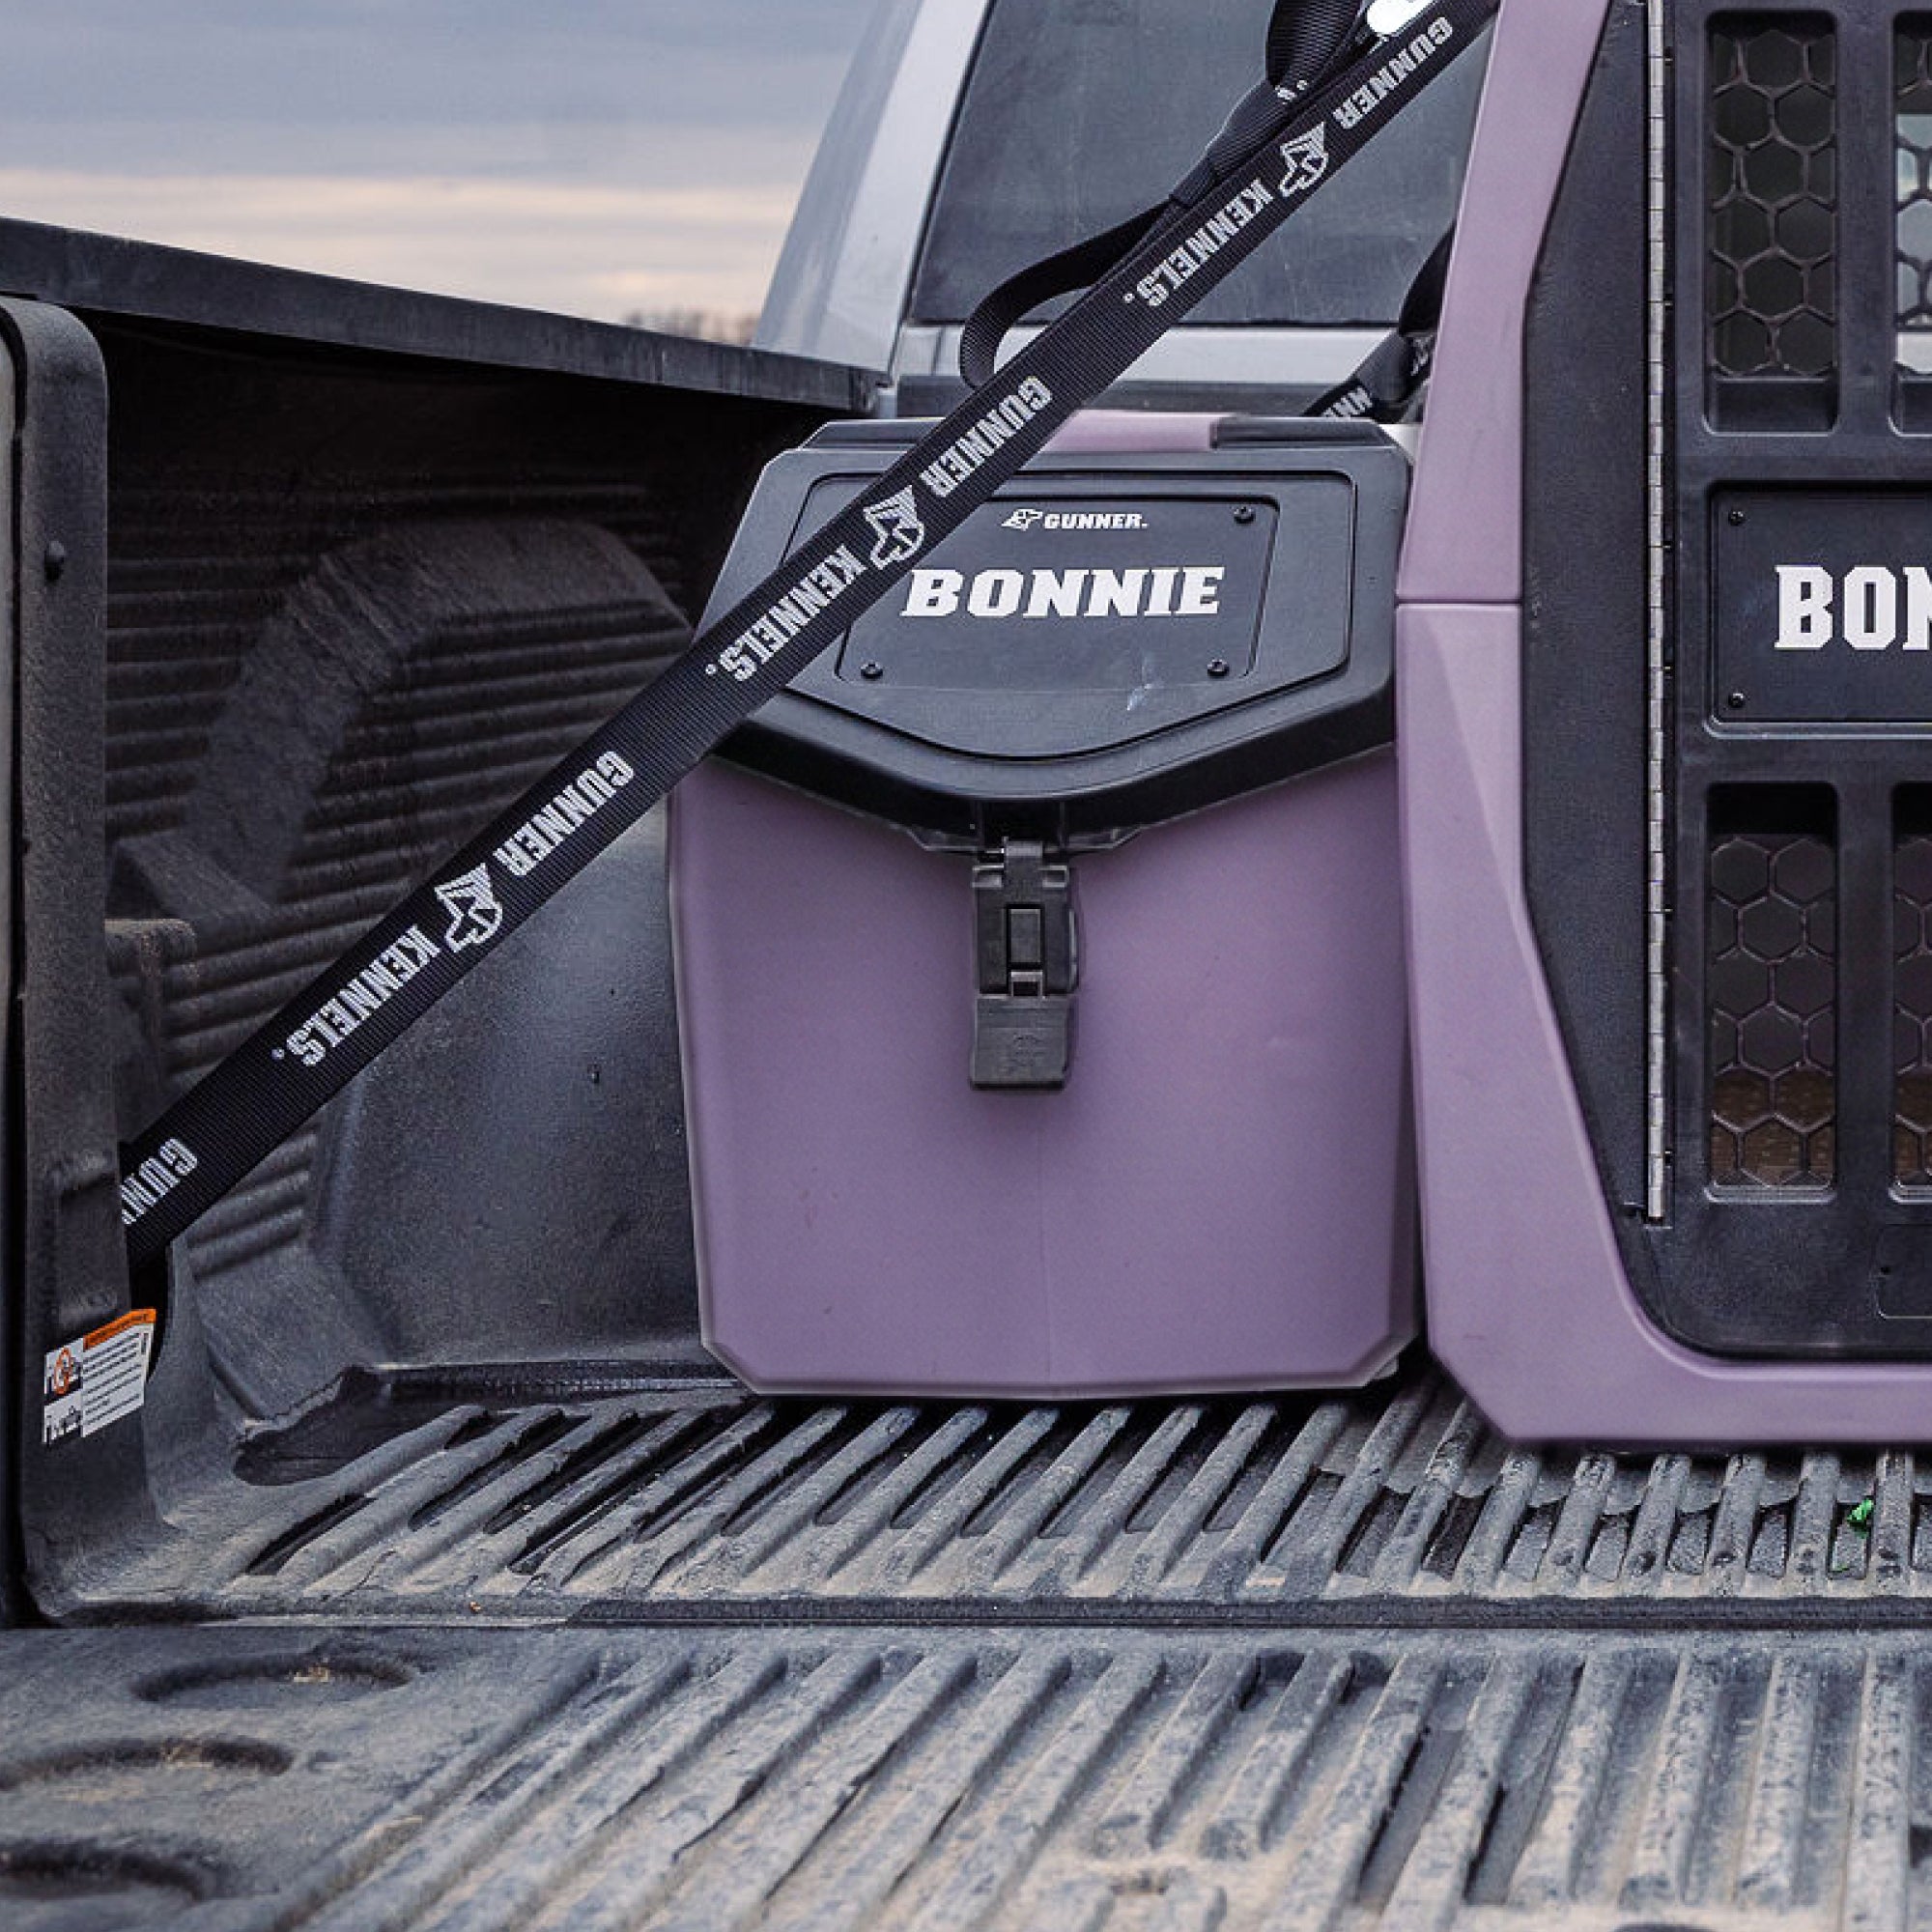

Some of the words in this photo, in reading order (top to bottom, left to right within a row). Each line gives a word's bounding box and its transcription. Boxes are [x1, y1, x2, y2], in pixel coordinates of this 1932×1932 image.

[1332, 16, 1453, 129] GUNNER
[1122, 179, 1274, 306] KENNELS.
[920, 376, 1052, 497] GUNNER
[1044, 513, 1149, 530] GUNNER.
[705, 545, 867, 682] KENNELS.
[899, 566, 1225, 617] BONNIE
[493, 751, 635, 877] GUNNER
[271, 923, 441, 1066] KENNELS.
[120, 1138, 198, 1225] GUN
